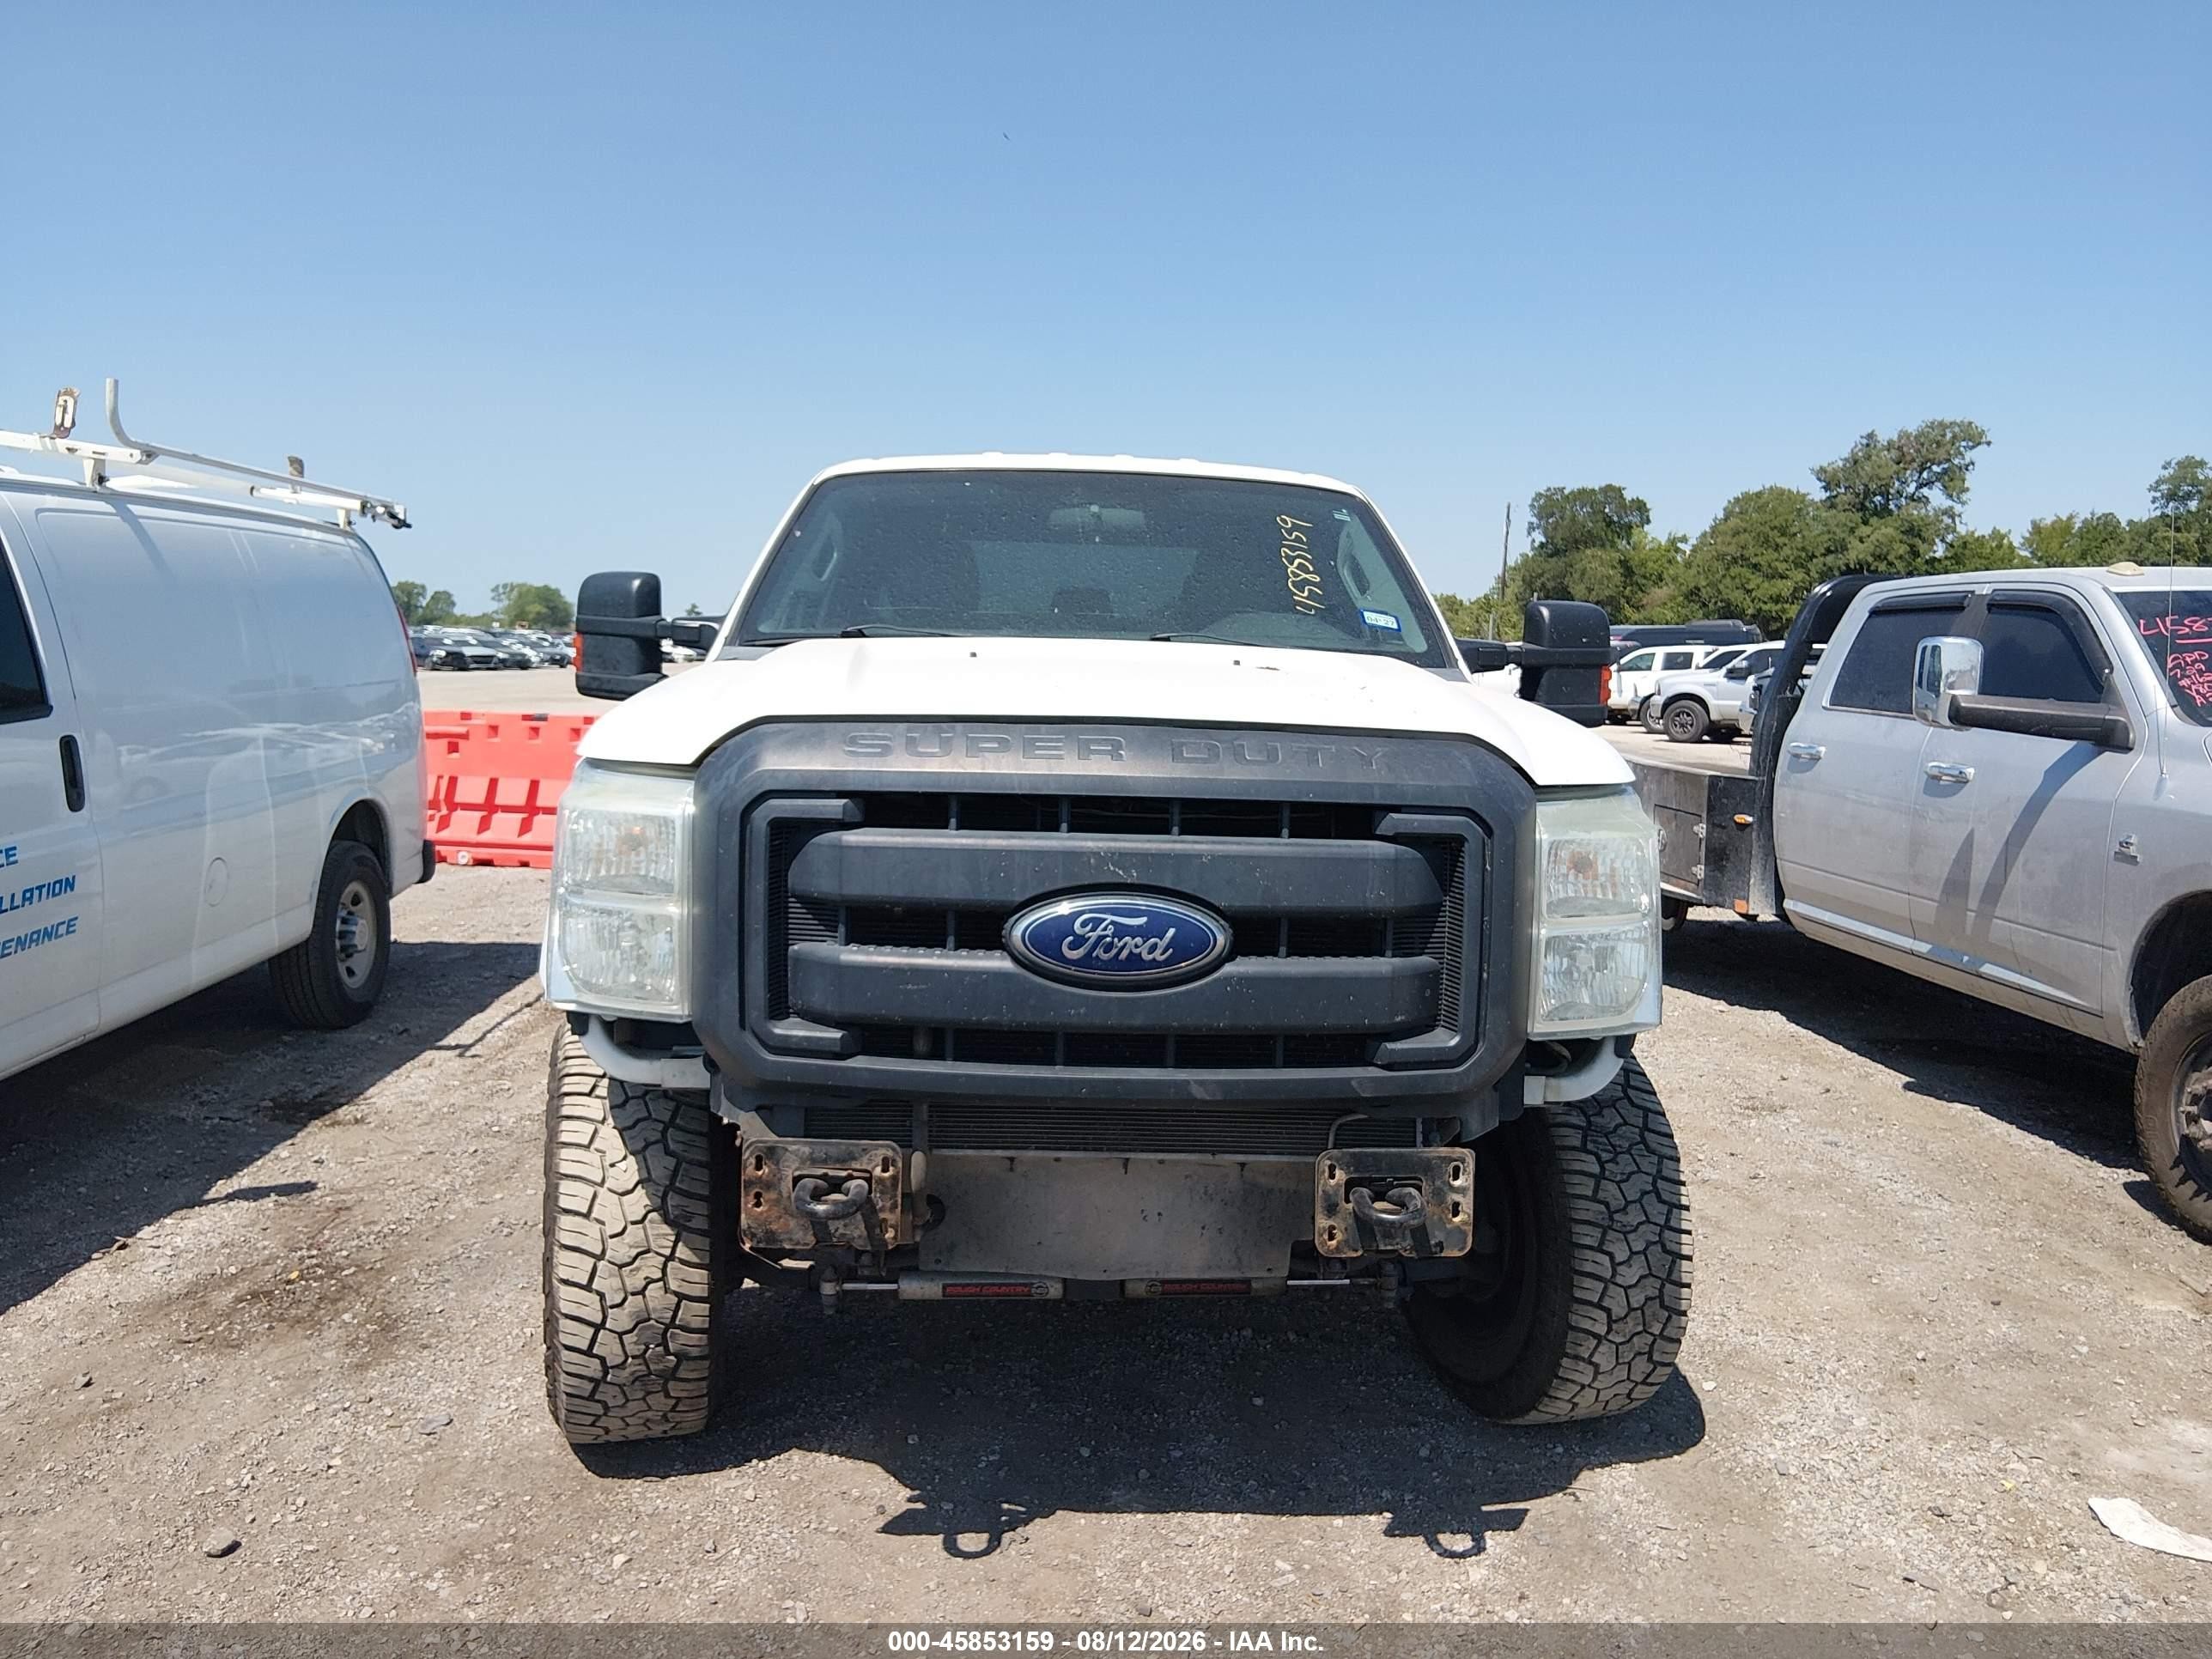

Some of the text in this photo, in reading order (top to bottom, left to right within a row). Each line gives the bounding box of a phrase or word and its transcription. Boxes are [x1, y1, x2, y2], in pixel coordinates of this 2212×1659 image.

[1276, 514, 1326, 615] 45853159
[2139, 615, 2212, 636] 458
[843, 732, 1391, 769] SUPER DUTY
[0, 915, 79, 959] ENANCE
[1061, 913, 1176, 962] Ford
